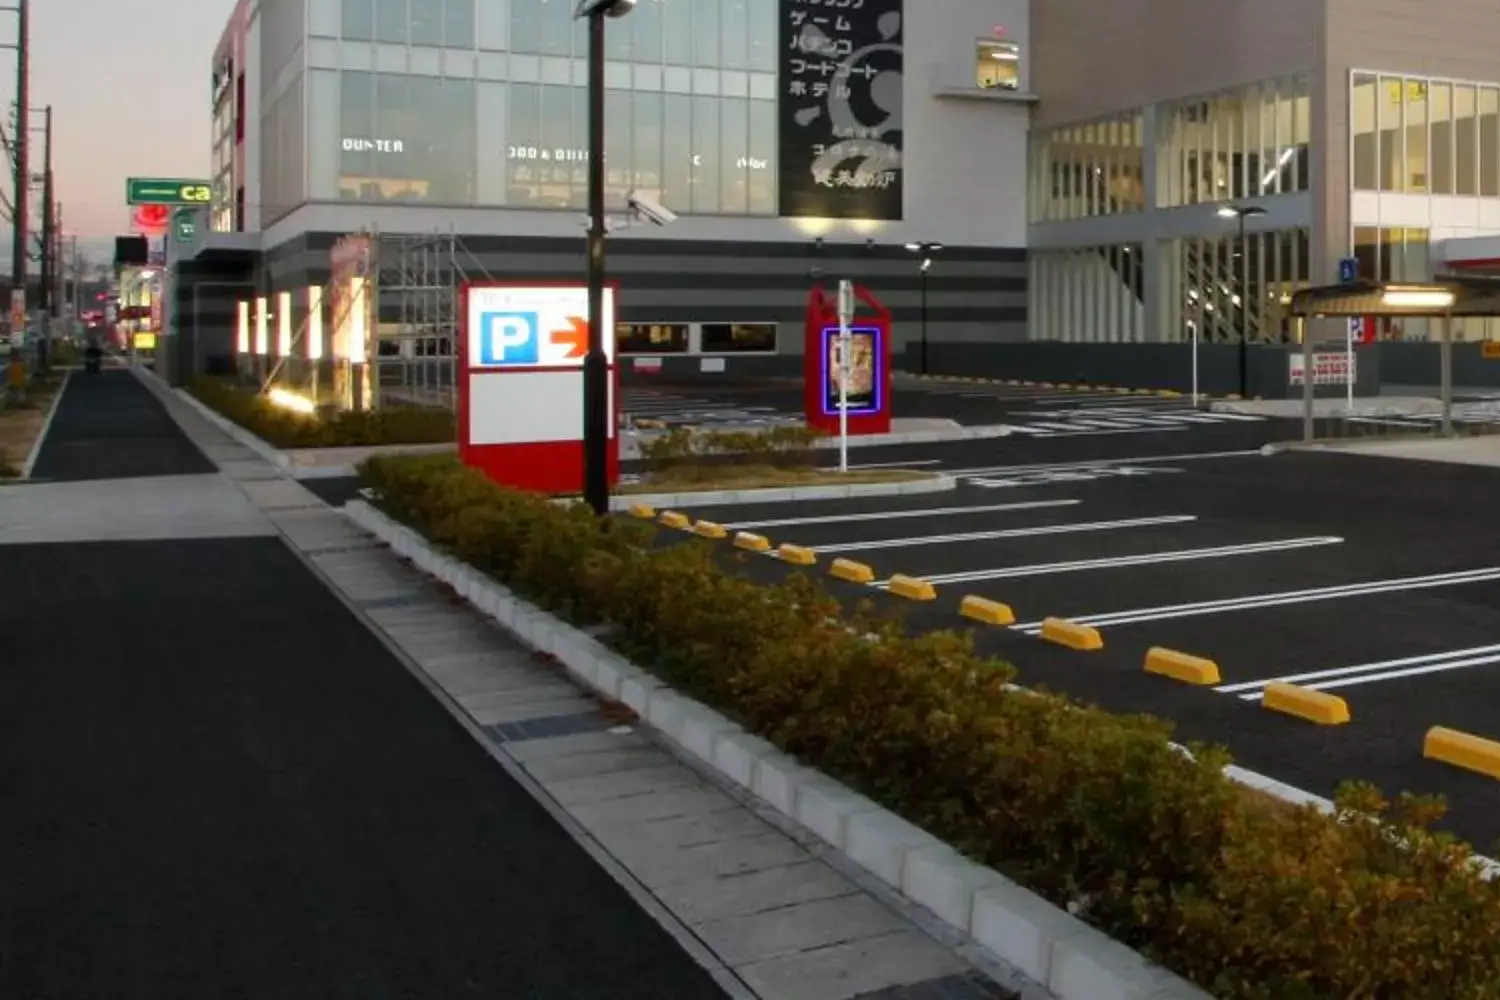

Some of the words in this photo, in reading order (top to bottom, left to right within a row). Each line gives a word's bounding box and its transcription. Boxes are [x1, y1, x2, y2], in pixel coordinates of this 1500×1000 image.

[789, 11, 851, 31] ゲーム
[789, 59, 878, 80] フードコート
[788, 80, 851, 98] ホテル
[491, 316, 531, 361] P
